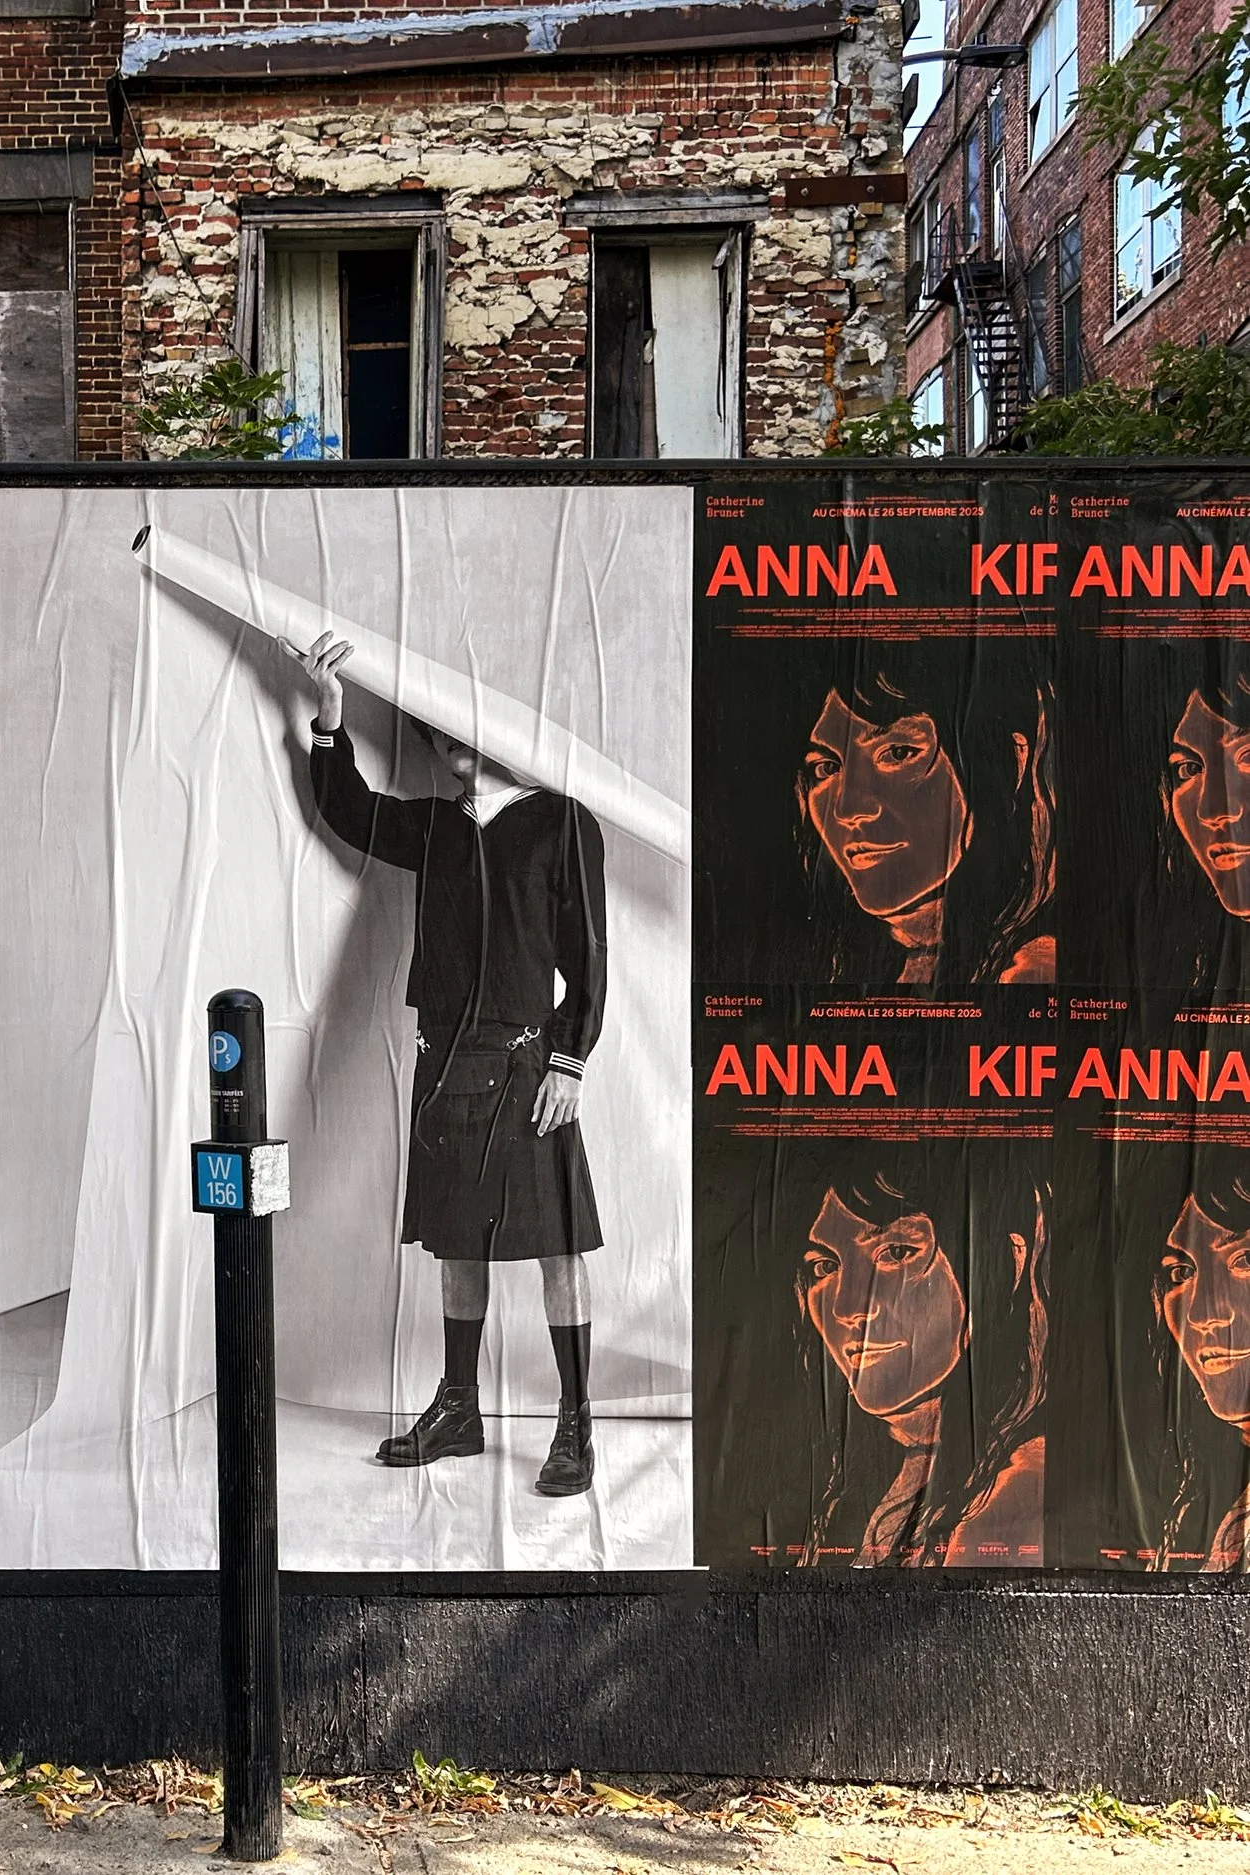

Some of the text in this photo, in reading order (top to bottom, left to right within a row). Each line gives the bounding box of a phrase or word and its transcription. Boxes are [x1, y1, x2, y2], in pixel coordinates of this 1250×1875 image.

[706, 496, 764, 506] Catherine
[1050, 495, 1058, 504] M
[1070, 496, 1129, 506] Catherine
[706, 508, 745, 518] Brunet
[813, 506, 984, 517] AU CINÉMA LE 26 SEPTEMBRE 2025
[1030, 505, 1043, 516] de
[1071, 508, 1110, 518] Brunet
[1176, 508, 1190, 517] AU
[1192, 506, 1233, 517] CINÉMA
[1234, 508, 1246, 517] LE
[705, 545, 898, 597] ANNA
[1070, 544, 1250, 598] ANNA
[705, 995, 763, 1006] Catherine
[1070, 998, 1128, 1009] Catherine
[705, 1007, 743, 1018] Brunet
[810, 1006, 982, 1018] AU CINÉMA LE 26 SEPTEMBRE 2025
[1028, 1008, 1041, 1018] de
[1070, 1010, 1108, 1020] Brunet
[1174, 1013, 1188, 1022] AU
[1190, 1012, 1228, 1024] CINÉMA
[1230, 1015, 1243, 1024] LE
[705, 1044, 897, 1096] ANNA
[1068, 1047, 1250, 1103] ANNA
[208, 1156, 232, 1180] W
[206, 1182, 237, 1206] 156
